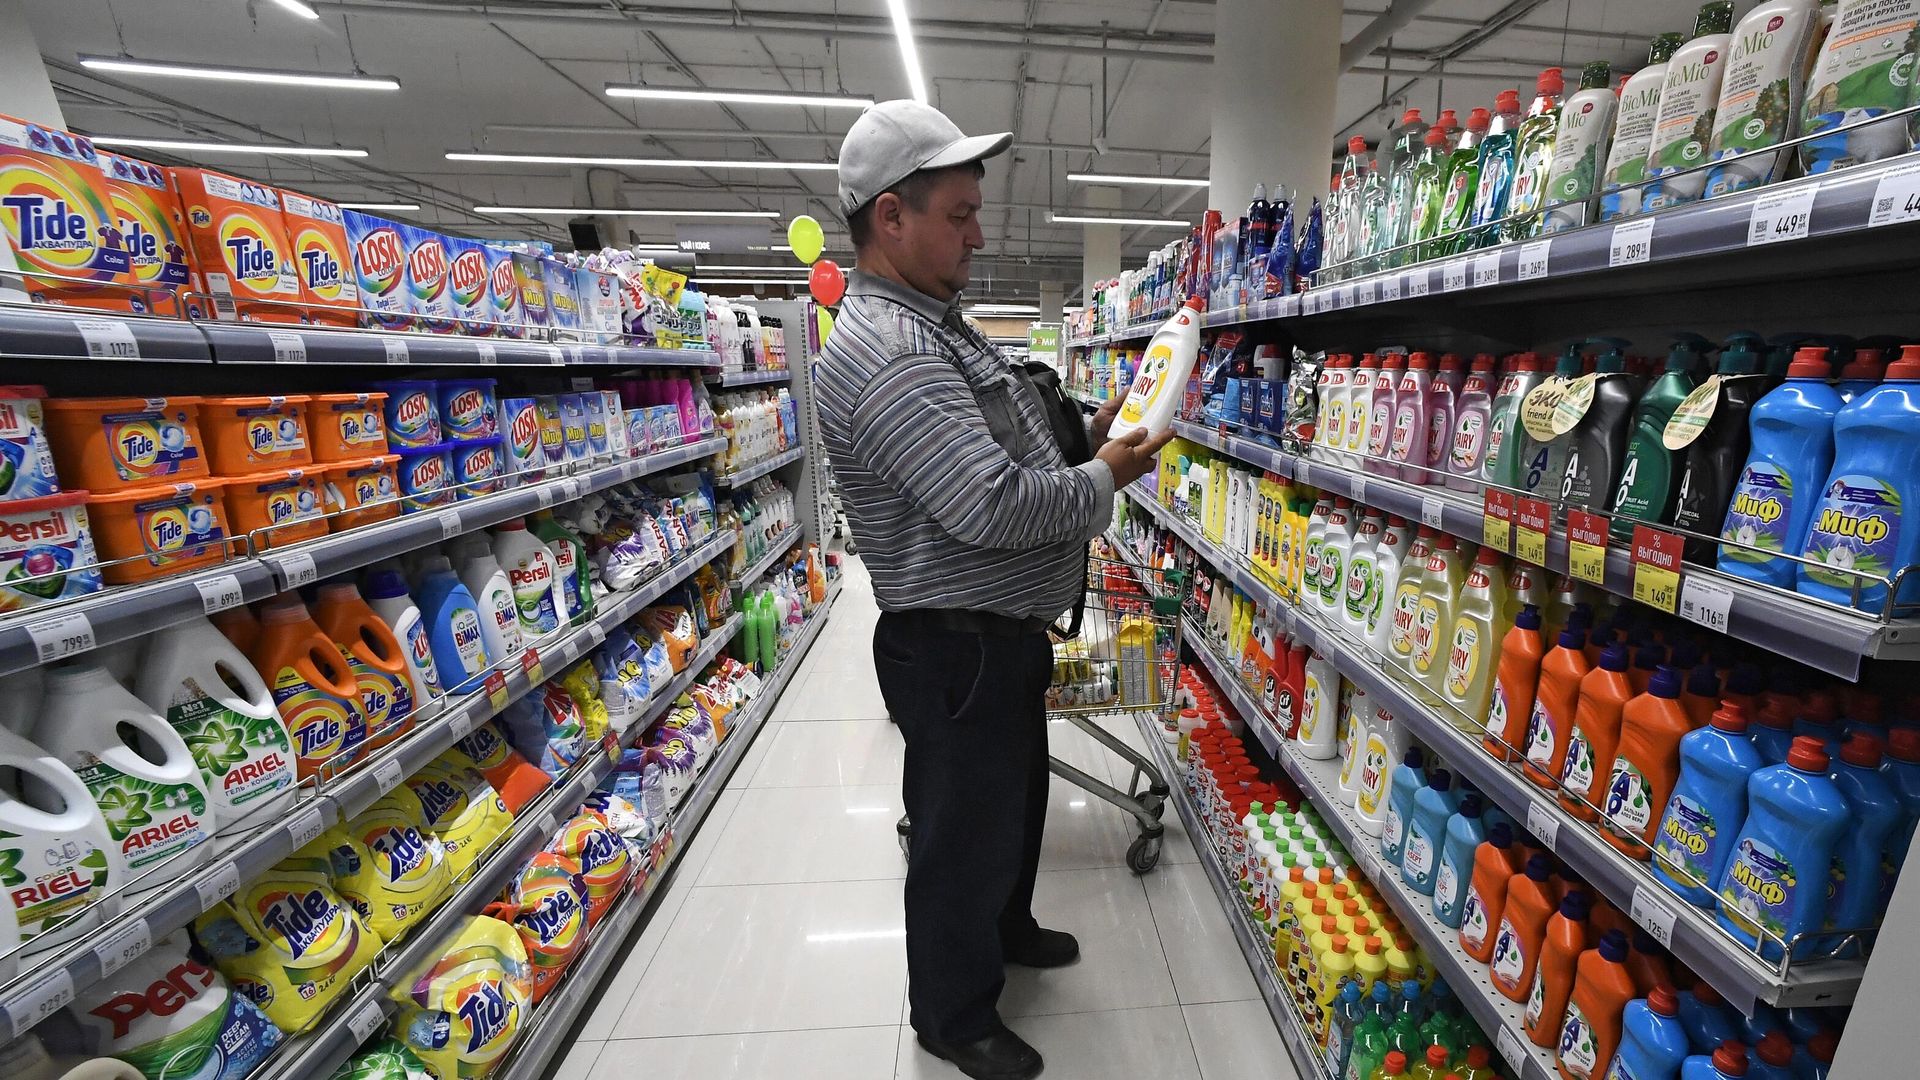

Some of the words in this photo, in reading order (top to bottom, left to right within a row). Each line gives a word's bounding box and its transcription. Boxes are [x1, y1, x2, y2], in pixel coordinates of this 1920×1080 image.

[1875, 3, 1911, 18] ФРУКТОВ
[1565, 112, 1587, 130] Mio
[3, 197, 86, 250] Tide
[191, 210, 210, 225] Tide
[1775, 215, 1798, 235] 449
[227, 239, 274, 280] Tide
[357, 233, 401, 276] LOSK
[1626, 243, 1641, 259] 289
[301, 251, 338, 289] Tide
[409, 244, 446, 284] LOSK
[451, 253, 486, 290] LOSK
[1530, 262, 1541, 275] 269
[492, 261, 516, 296] LOSK
[399, 394, 428, 423] LOSK
[450, 390, 481, 418] LOSK
[343, 423, 359, 440] Tide
[512, 407, 537, 444] LOSK
[122, 436, 153, 462] Tide
[251, 427, 273, 450] Tide
[1455, 431, 1475, 450] FAIRY
[413, 458, 441, 487] LOSK
[465, 450, 491, 476] LOSK
[358, 486, 375, 505] Tide
[271, 502, 293, 524] Tide
[1488, 503, 1509, 519] ВЫГОДНО
[1733, 491, 1782, 524] Миф
[1520, 513, 1545, 529] ВЫГОДНО
[1820, 509, 1889, 546] Миф
[153, 522, 182, 548] Tide
[1572, 528, 1601, 544] ВЫГОДНО
[1653, 534, 1662, 549] %
[556, 550, 574, 566] rsil
[1637, 546, 1673, 567] ВЫГОДНО
[299, 569, 311, 582] 699
[509, 562, 550, 587] Persil
[221, 592, 236, 606] 699
[1651, 588, 1666, 605] 149
[495, 604, 517, 627] BiMAX
[1394, 607, 1413, 631] FAIRY
[1701, 606, 1717, 625] 116
[61, 635, 84, 652] 799
[455, 625, 481, 648] BiMAX
[394, 703, 410, 713] Color
[294, 718, 340, 758] Tide
[348, 731, 364, 741] Color
[224, 753, 285, 790] ARIEL
[225, 786, 246, 797] ГЕЛЬ
[251, 765, 288, 787] КОНЦЕНТРАТ
[122, 815, 199, 855] ARIEL
[1384, 824, 1395, 836] SEPT
[1538, 826, 1550, 844] 216
[1665, 816, 1708, 855] Миф
[124, 847, 146, 860] ГЕЛЬ
[153, 826, 200, 850] КОНЦЕНТРАТ
[372, 826, 424, 883] Tide
[1407, 850, 1423, 865] ASEPT
[35, 865, 74, 883] COLOR
[1733, 860, 1788, 906] Миф
[11, 871, 92, 909] RIEL
[262, 889, 330, 961] Tide
[1647, 918, 1662, 939] 125
[221, 1020, 241, 1043] DEEP
[224, 1022, 250, 1050] CLEAN
